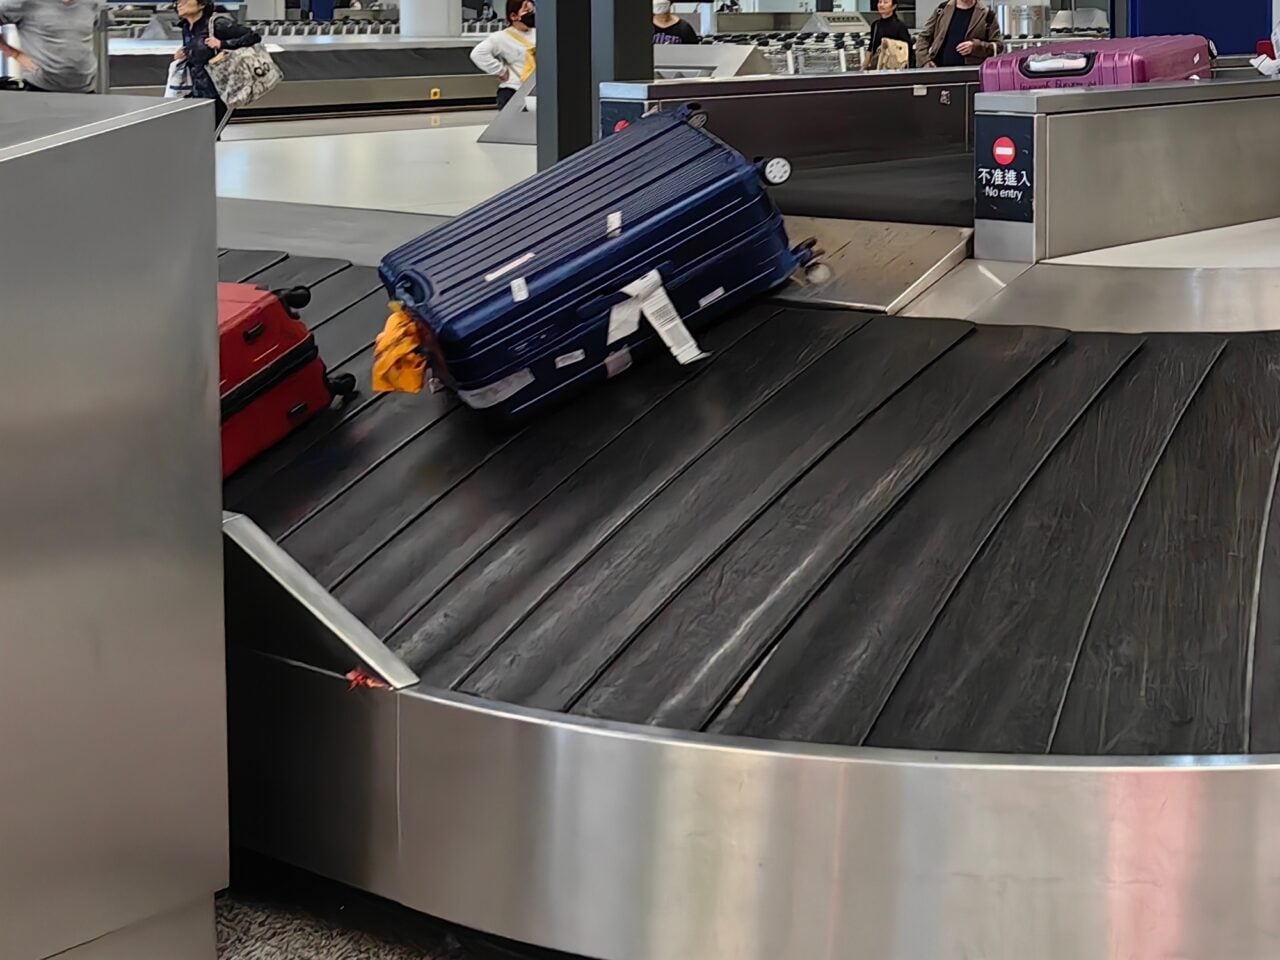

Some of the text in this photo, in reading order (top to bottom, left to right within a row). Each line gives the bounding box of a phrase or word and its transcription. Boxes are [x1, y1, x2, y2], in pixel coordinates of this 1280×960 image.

[978, 168, 1031, 187] 不准進入
[985, 185, 1023, 201] No entry
